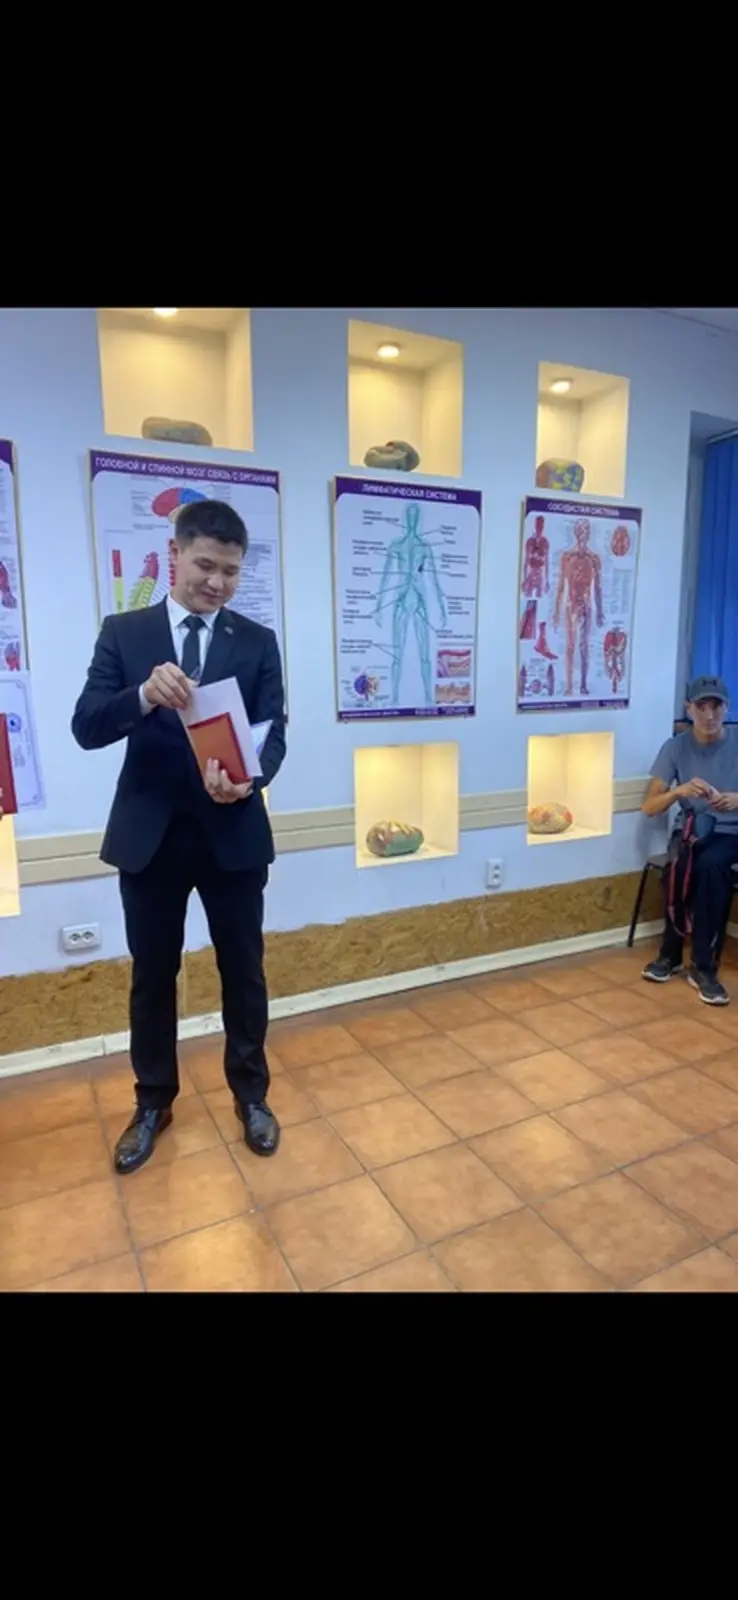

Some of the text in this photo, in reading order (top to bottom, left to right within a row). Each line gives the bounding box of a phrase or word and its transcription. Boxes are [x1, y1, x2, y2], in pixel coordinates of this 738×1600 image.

[95, 457, 139, 471] ГОЛОВНОЙ
[141, 463, 146, 471] И
[148, 463, 184, 475] СПИННОЙ
[186, 467, 206, 477] МОЗГ
[232, 471, 238, 481] С
[425, 490, 457, 501] СИСТЕМА
[547, 502, 620, 516] СОСУДИСТАЯ СИСТЕМА
